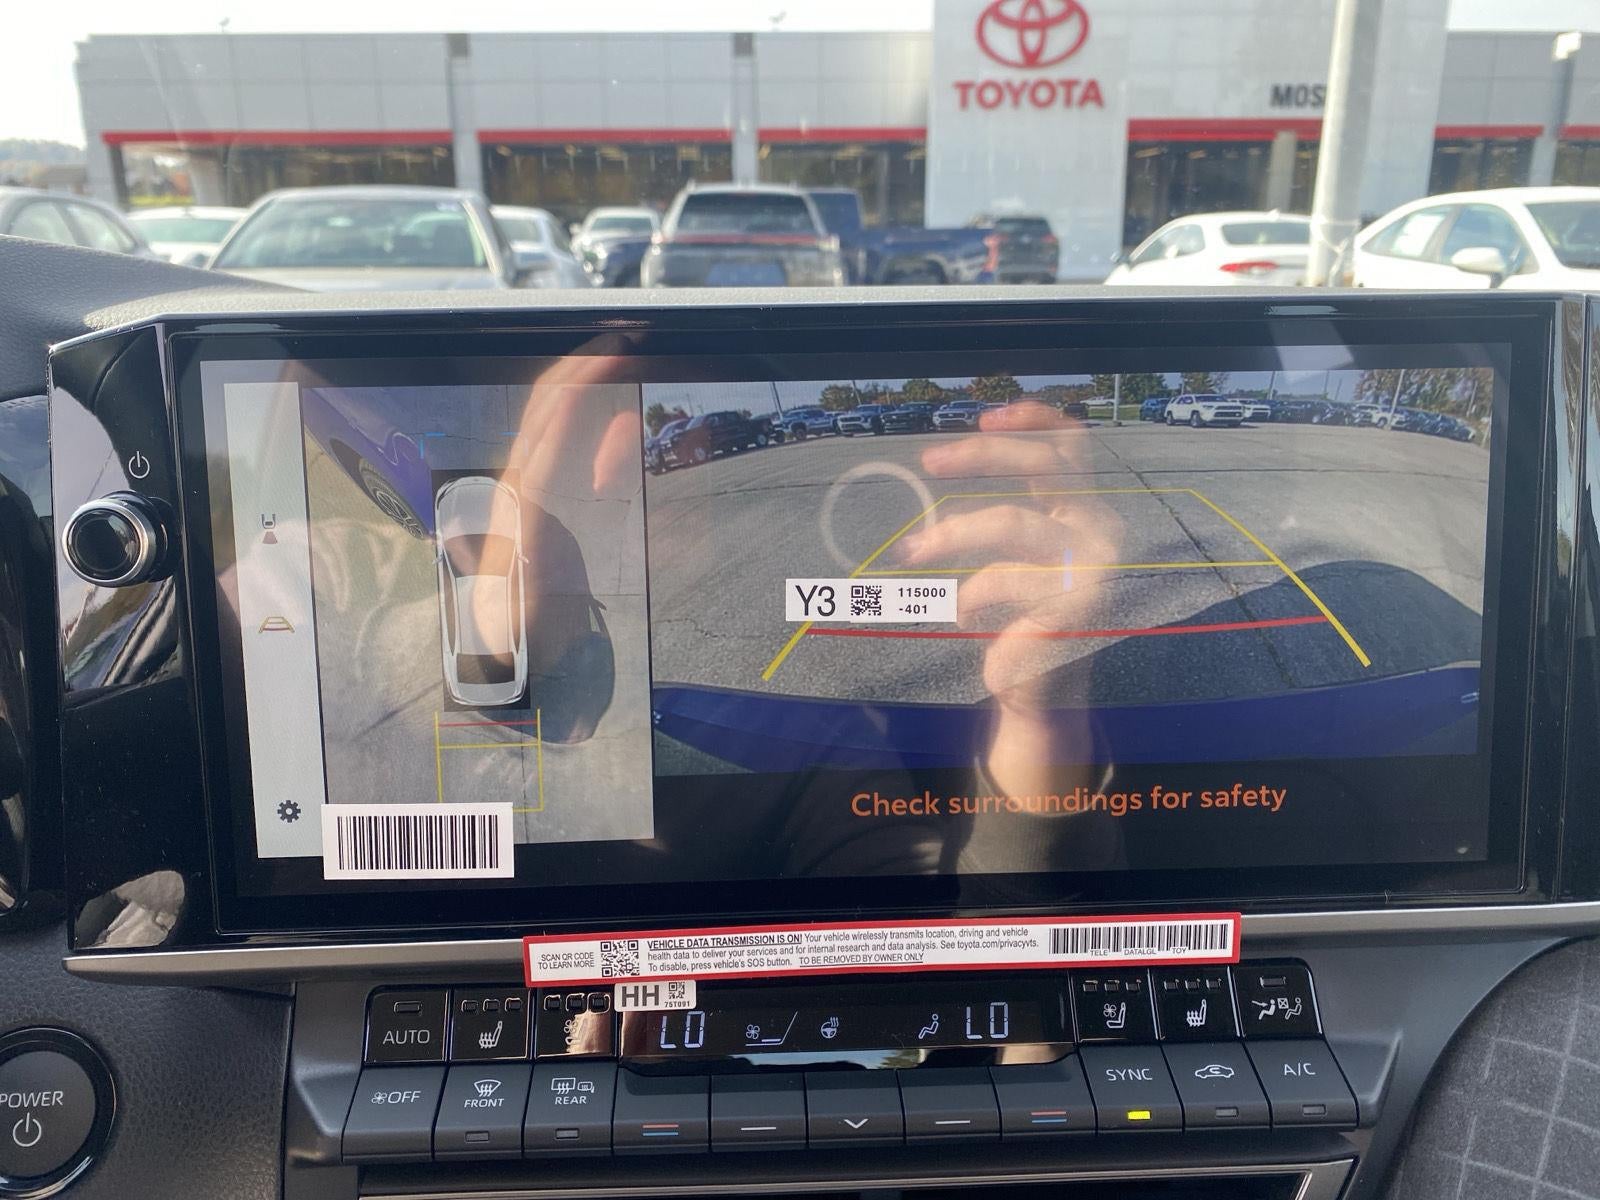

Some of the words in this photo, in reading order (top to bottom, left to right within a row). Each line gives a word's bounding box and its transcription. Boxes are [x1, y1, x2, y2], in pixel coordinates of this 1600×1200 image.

[952, 79, 1105, 110] TOYOTA
[898, 587, 946, 598] 115000
[795, 585, 836, 617] Y3
[899, 604, 928, 614] -401
[851, 791, 939, 816] Check
[948, 787, 1142, 817] surroundings
[1150, 785, 1192, 809] for
[1200, 783, 1287, 812] safety
[647, 939, 684, 950] VEHICLE
[687, 938, 709, 948] DATA
[711, 934, 775, 947] TRANSMISSION
[777, 934, 786, 943] IS
[804, 933, 822, 942] Your
[824, 932, 850, 941] vehicle
[852, 931, 888, 943] wirelessly
[890, 930, 924, 939] transmits
[926, 929, 957, 939] location,
[959, 928, 983, 939] driving
[986, 927, 1000, 937] and
[1002, 927, 1028, 937] vehicle
[541, 953, 560, 961] SCAN
[562, 953, 572, 961] QR
[574, 952, 594, 960] CODE
[648, 950, 671, 961] health
[673, 949, 690, 960] data
[692, 950, 699, 958] to
[702, 948, 726, 958] deliver
[728, 949, 744, 960] your
[747, 946, 777, 956] services
[780, 945, 793, 954] and
[796, 945, 805, 954] for
[808, 944, 835, 953] internal
[837, 943, 869, 952] research
[872, 942, 886, 951] and
[888, 942, 904, 951] data
[906, 941, 937, 952] analysis.
[940, 940, 955, 949] See
[1090, 949, 1108, 957] TELE
[550, 961, 572, 969] LEARN
[574, 960, 595, 968] MORE
[648, 963, 658, 972] To
[660, 962, 689, 972] disable,
[691, 961, 711, 972] press
[714, 959, 745, 970] vehicle's
[747, 958, 764, 967] SOS
[767, 957, 792, 967] button.
[800, 957, 810, 965] TO
[812, 956, 821, 964] BE
[824, 954, 860, 963] REMOVED
[863, 954, 872, 962] BY
[874, 953, 902, 961] OWNER
[904, 953, 924, 961] ONLY
[622, 985, 660, 1007] HH
[966, 1002, 1009, 1039] LO
[382, 1030, 430, 1044] AUTO
[660, 1011, 706, 1049] LO
[1106, 1068, 1153, 1081] SYNC
[1284, 1062, 1316, 1077] A/C
[0, 1091, 64, 1108] POWER
[387, 1091, 422, 1104] OFF
[464, 1099, 504, 1108] FRONT
[555, 1095, 587, 1105] REAR
